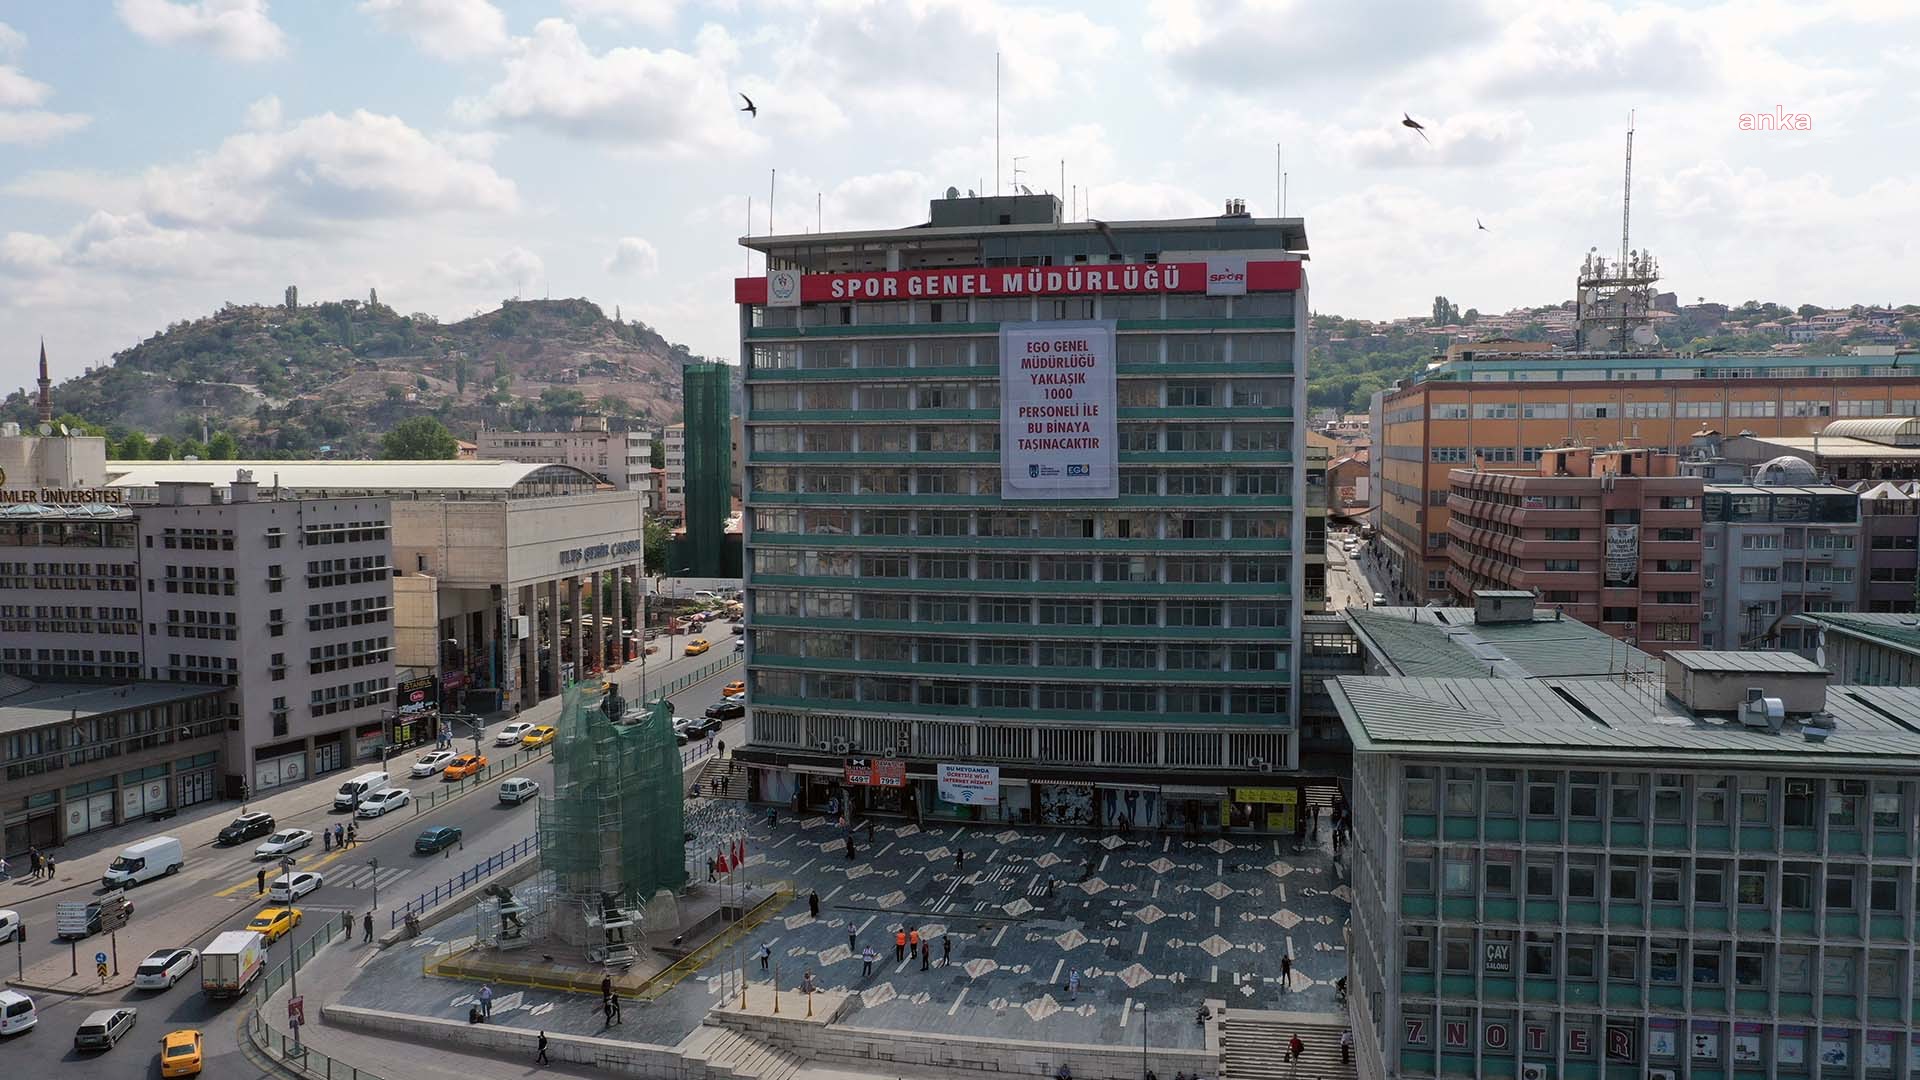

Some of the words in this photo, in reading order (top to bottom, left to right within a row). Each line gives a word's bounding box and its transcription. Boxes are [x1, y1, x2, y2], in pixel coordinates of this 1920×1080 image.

[831, 277, 897, 298] SPOR
[907, 274, 992, 296] GENEL
[1002, 265, 1179, 293] MÜDÜRLÜĞÜ
[1027, 341, 1050, 353] EGO
[1054, 340, 1089, 352] GENEL
[1021, 354, 1095, 369] MÜDÜRLÜĞÜ
[1030, 372, 1086, 387] YAKLAŞIK
[1044, 388, 1073, 400] 1000
[1019, 403, 1079, 418] PERSONELİ
[1083, 402, 1099, 416] İLE
[1028, 422, 1042, 434] BU
[1047, 419, 1090, 433] BİNAYA
[1018, 438, 1100, 452] TAŞINACAKTIR
[41, 487, 122, 503] ÜNİVERSİTESİ
[1487, 944, 1508, 961] ÇAY
[1486, 962, 1508, 970] SALONU
[1406, 1020, 1428, 1044] 7.
[1446, 1022, 1630, 1058] NOTER
